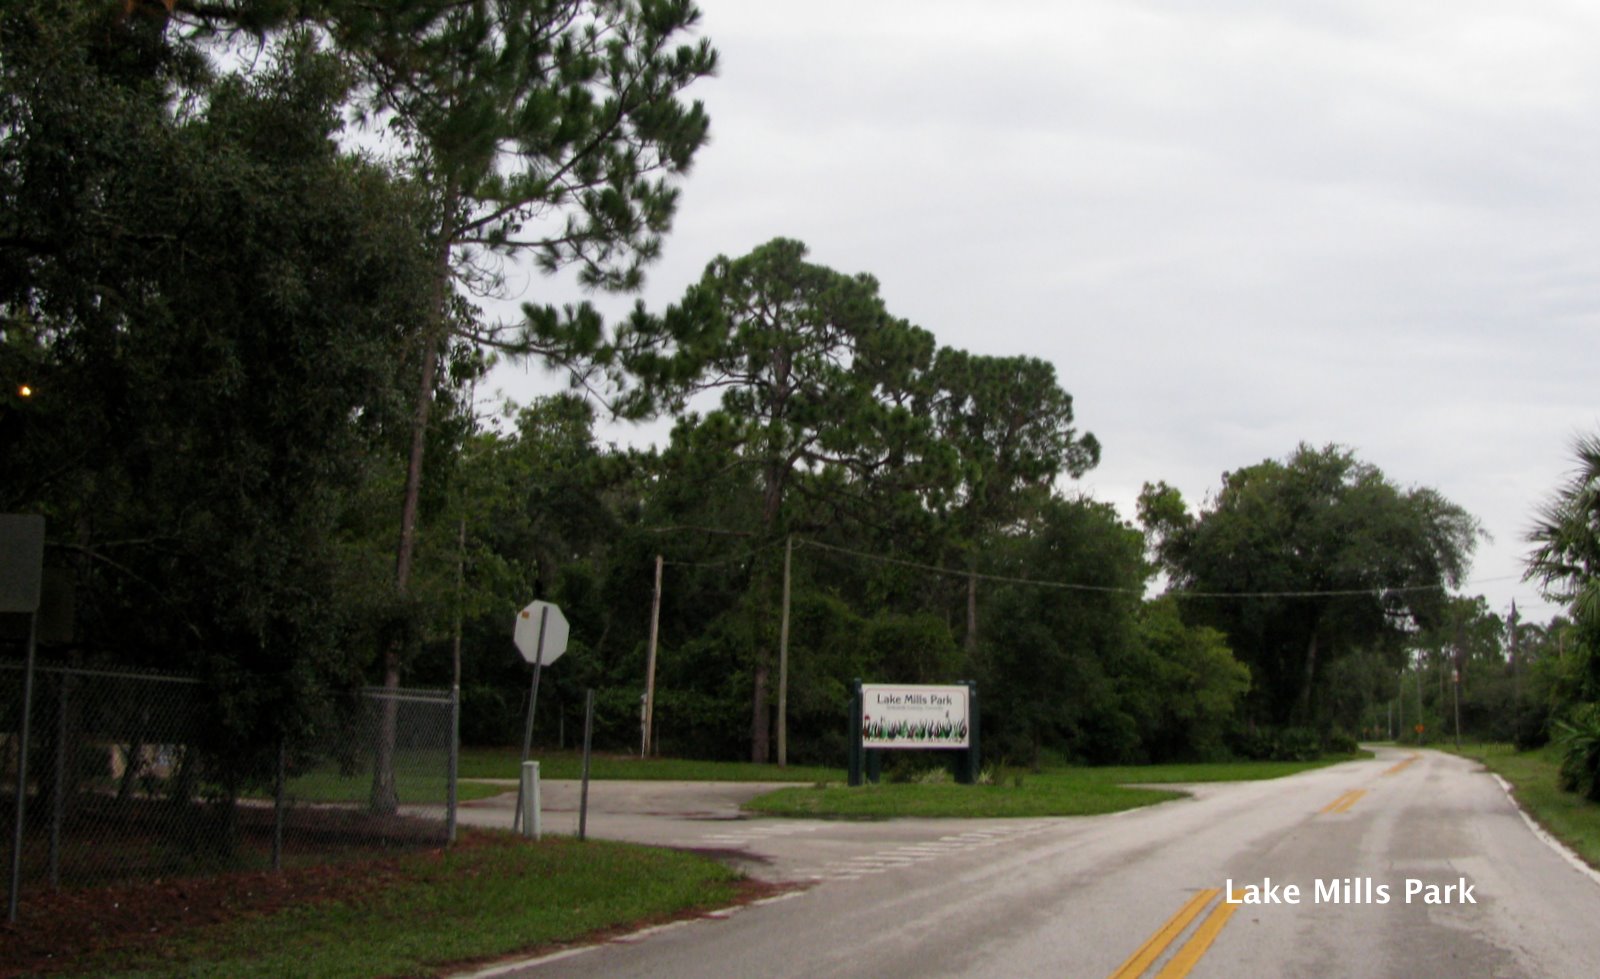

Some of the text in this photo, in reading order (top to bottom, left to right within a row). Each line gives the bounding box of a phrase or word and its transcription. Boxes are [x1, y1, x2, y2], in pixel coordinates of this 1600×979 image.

[877, 694, 952, 705] Lake Mills Park
